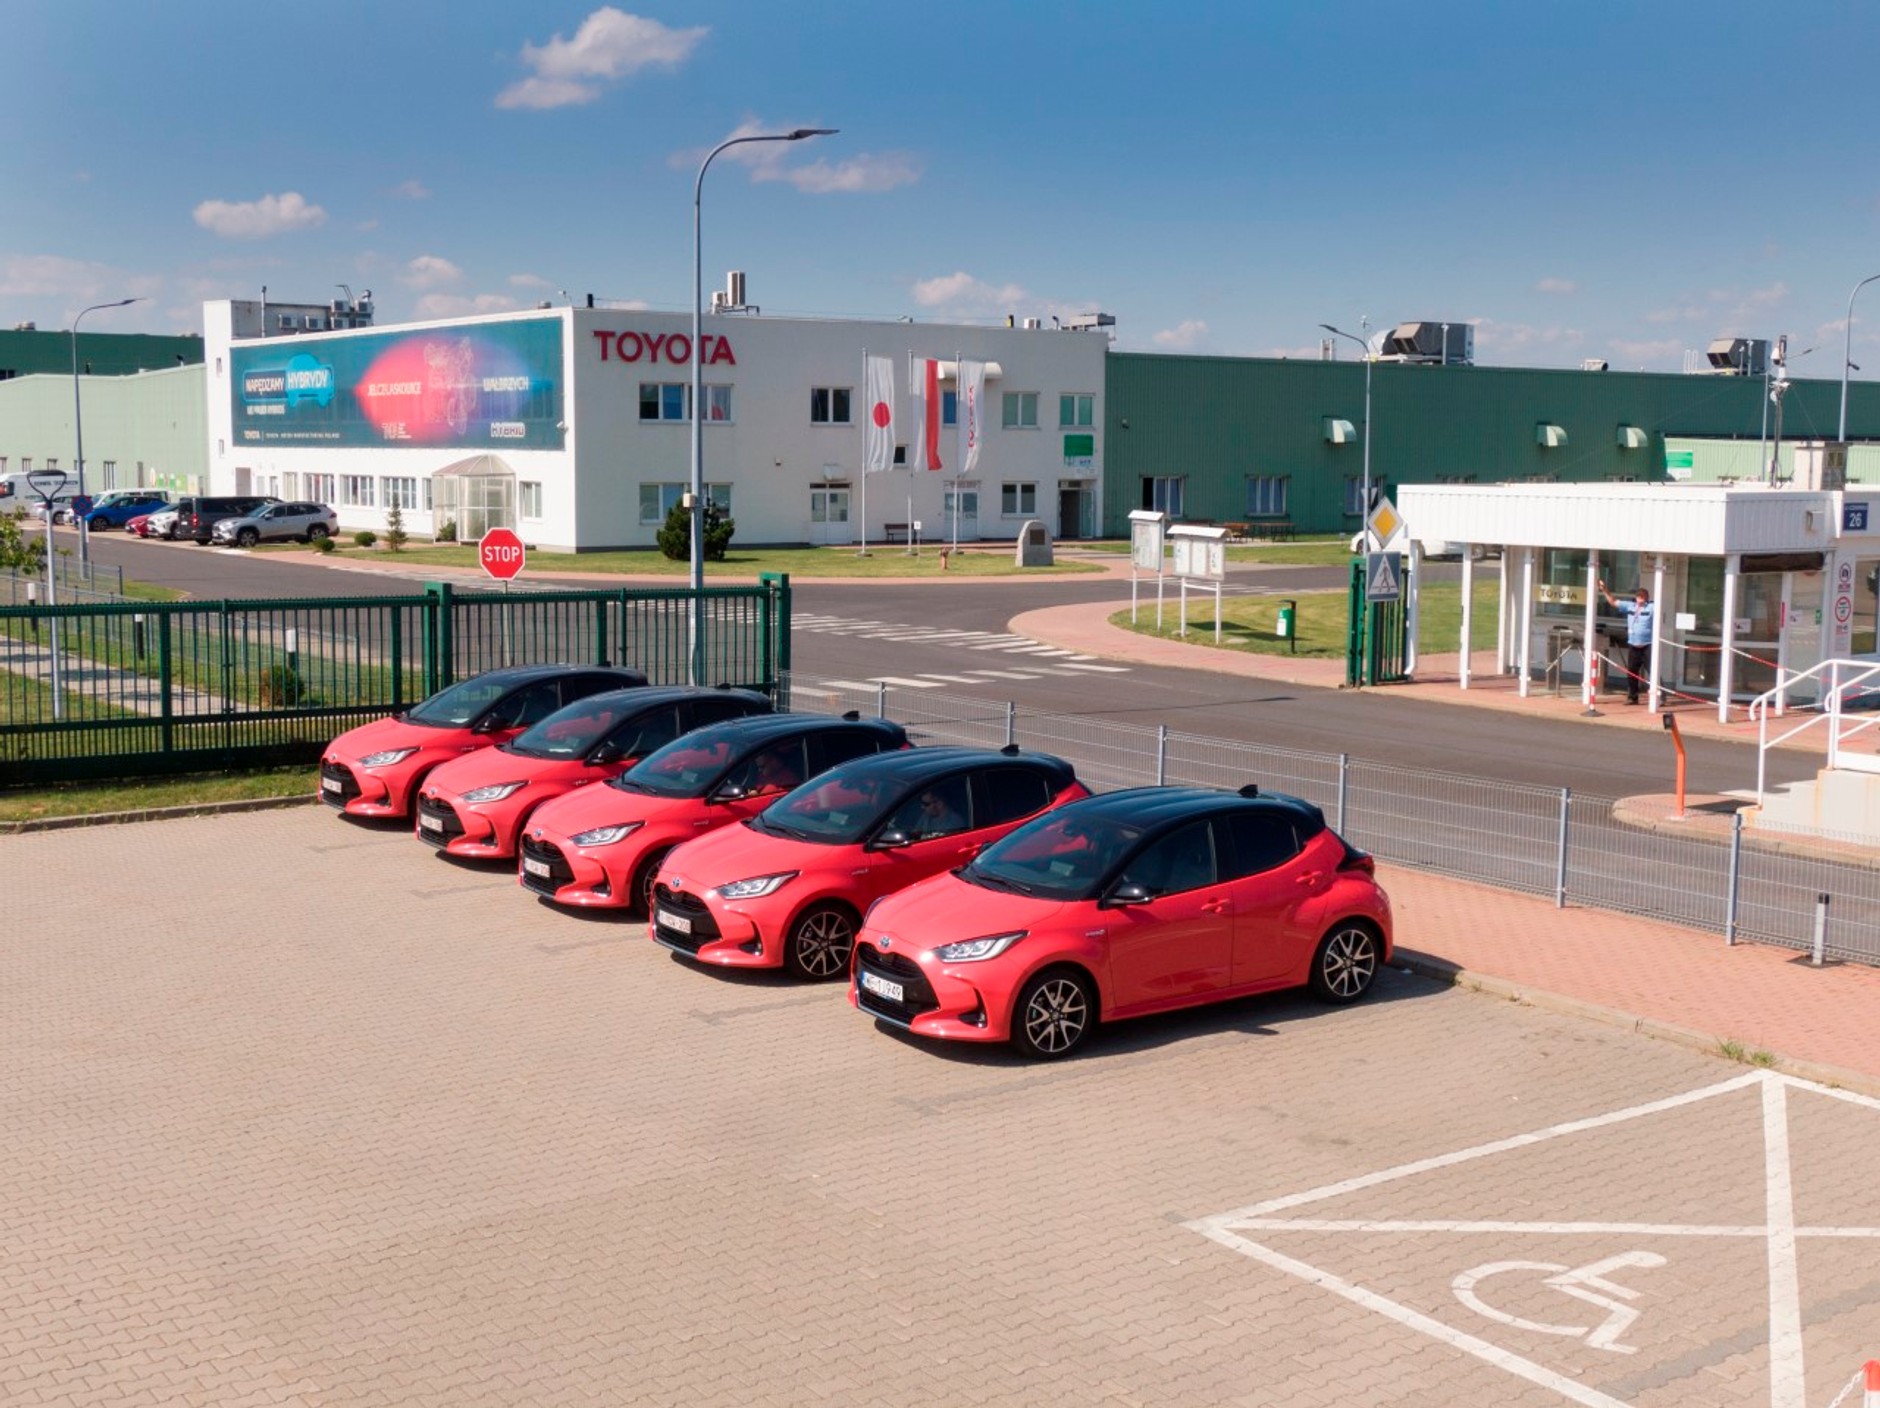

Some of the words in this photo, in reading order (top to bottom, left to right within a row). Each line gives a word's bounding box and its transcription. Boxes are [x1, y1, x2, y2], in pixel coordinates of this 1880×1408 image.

[593, 330, 736, 365] TOYOTA
[287, 369, 329, 390] HYBRYDY
[1849, 512, 1863, 527] 26
[485, 546, 520, 562] STOP
[1541, 588, 1578, 600] TOYOTA
